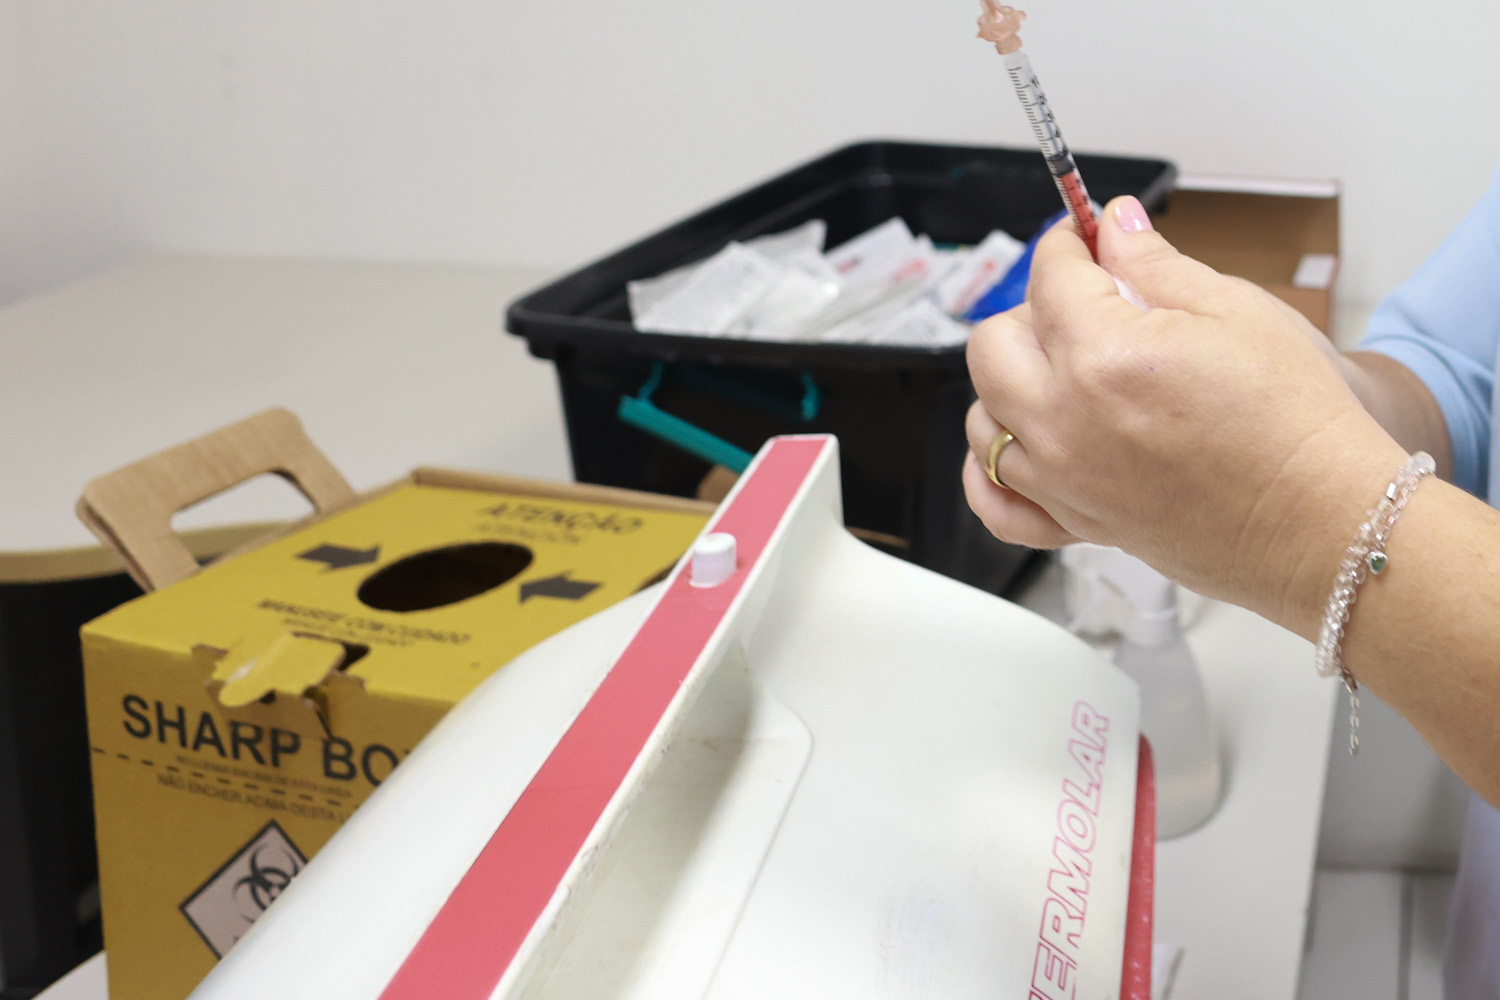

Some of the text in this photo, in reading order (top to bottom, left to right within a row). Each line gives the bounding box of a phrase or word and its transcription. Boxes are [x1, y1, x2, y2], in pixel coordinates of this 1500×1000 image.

[122, 693, 411, 787] SHARP BO
[157, 772, 186, 791] NÃO
[1028, 699, 1110, 1000] ERMOLAR
